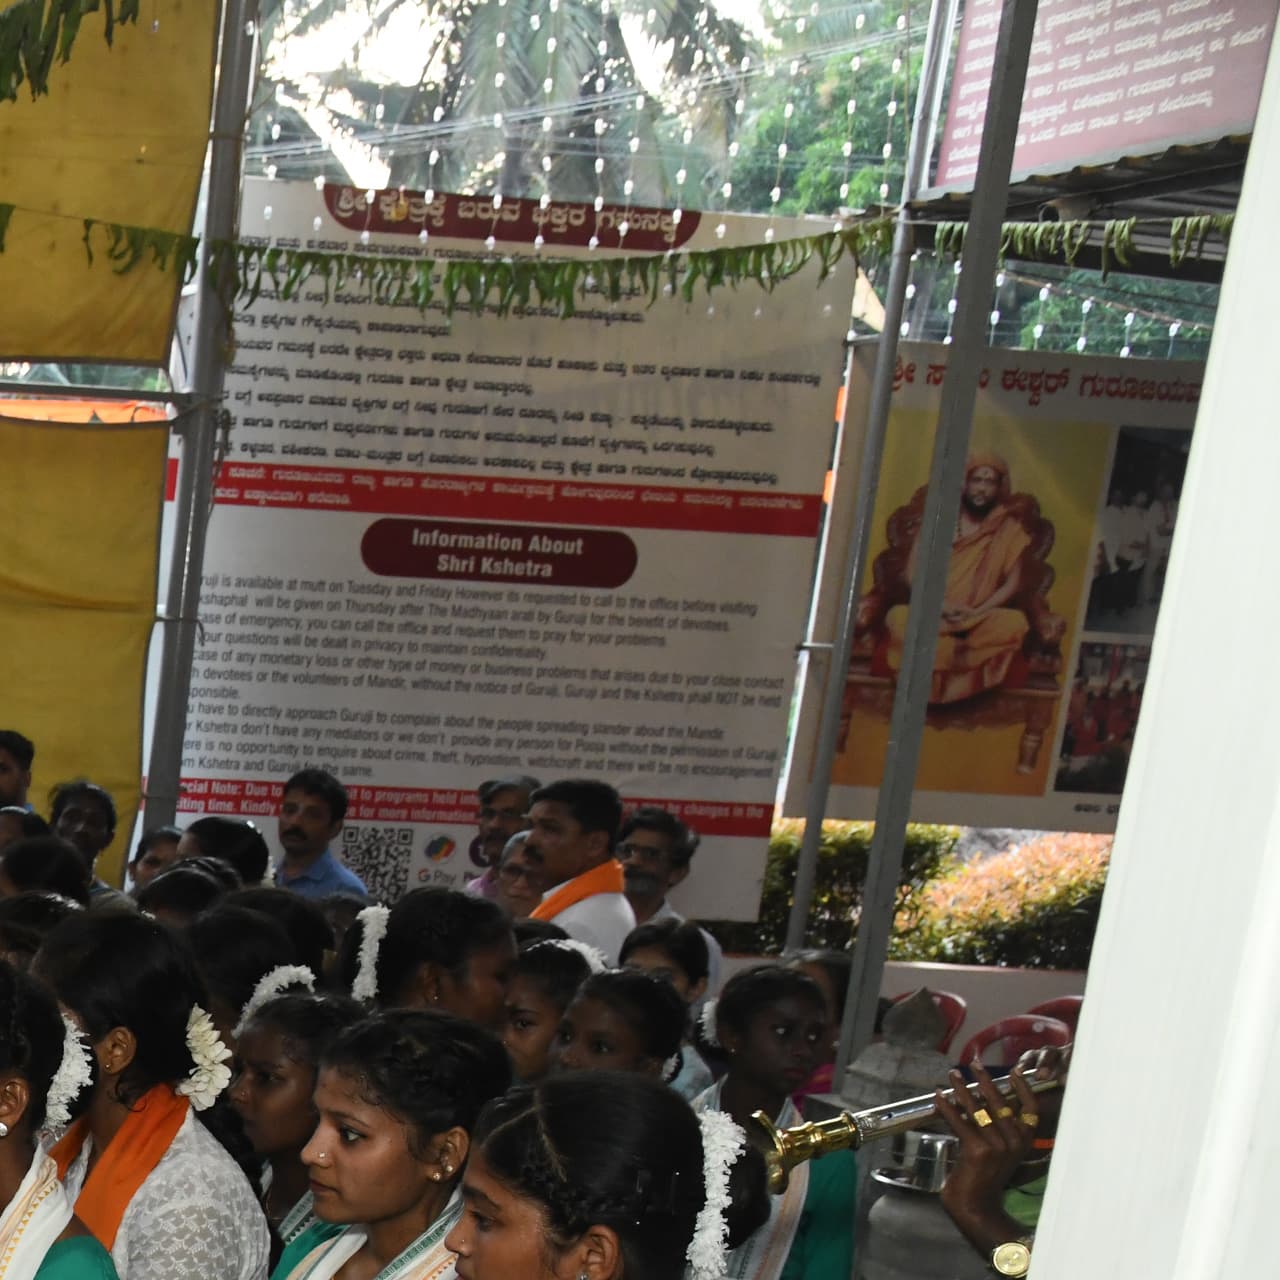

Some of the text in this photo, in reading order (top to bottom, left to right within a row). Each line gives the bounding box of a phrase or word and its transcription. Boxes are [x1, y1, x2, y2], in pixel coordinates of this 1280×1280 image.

[411, 528, 584, 555] Information About
[437, 554, 553, 577] Shri Kshetra
[221, 573, 231, 586] is
[234, 574, 284, 588] available
[286, 578, 298, 589] at
[299, 578, 326, 591] mutt
[328, 581, 344, 591] on
[254, 594, 274, 607] will
[276, 595, 291, 608] be
[293, 596, 323, 613] given
[326, 600, 342, 611] on
[224, 611, 236, 624] of
[239, 615, 302, 630] emergency,
[306, 618, 328, 632] you
[330, 619, 352, 630] can
[354, 618, 374, 631] call
[224, 630, 362, 649] questions will be dealt in
[220, 649, 385, 669] of any monetary loss or other
[202, 666, 364, 685] devotees or the volunteers of
[197, 701, 388, 724] have to directly approach Guruji to
[195, 719, 238, 733] Kshetra
[240, 721, 270, 735] don't
[272, 723, 299, 736] have
[301, 727, 322, 740] any
[324, 725, 380, 740] mediators
[204, 737, 358, 760] is no opportunity to enquire
[197, 755, 264, 771] Kshetra and
[211, 782, 242, 797] Note:
[245, 783, 269, 797] Due
[360, 789, 372, 802] to
[375, 791, 429, 807] programs
[432, 791, 457, 804] held
[208, 799, 235, 812] time.
[240, 800, 276, 816] Kindly
[359, 805, 375, 818] for
[378, 808, 408, 819] more
[434, 871, 457, 885] Pay
